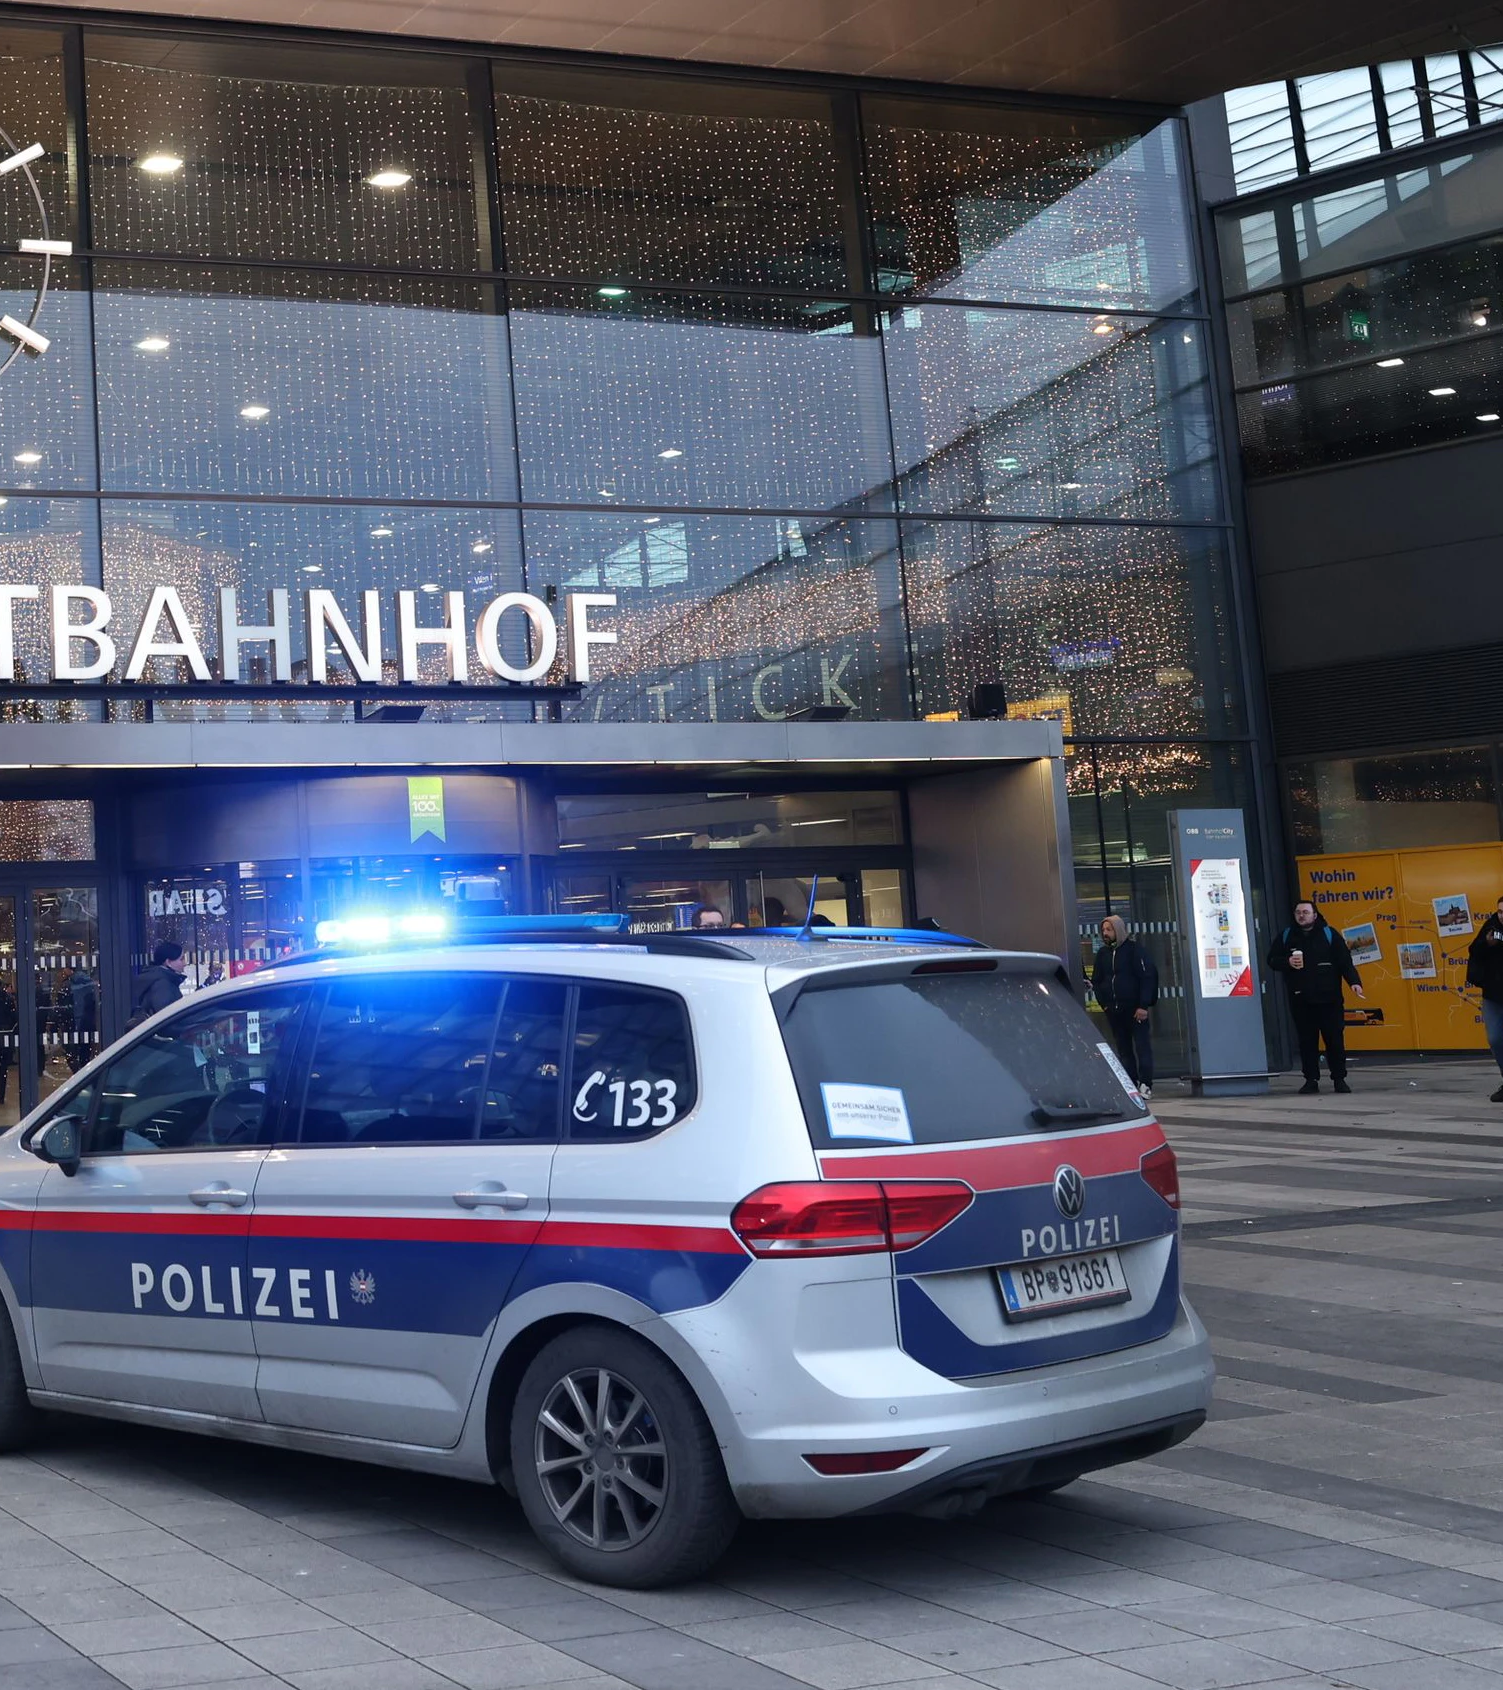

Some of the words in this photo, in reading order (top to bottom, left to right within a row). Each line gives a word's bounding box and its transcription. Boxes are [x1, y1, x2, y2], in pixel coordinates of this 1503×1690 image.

[1310, 869, 1355, 884] Wohin
[1312, 891, 1359, 904] fahren
[1363, 886, 1394, 900] wir?
[1376, 913, 1397, 923] Prag
[1449, 957, 1468, 966] Brün
[1417, 984, 1441, 992] Wien
[609, 1079, 677, 1127] 133
[1021, 1215, 1120, 1257] POLIZEI
[1021, 1267, 1045, 1301] BP
[1058, 1257, 1114, 1295] 91361
[131, 1262, 339, 1320] POLIZEI
